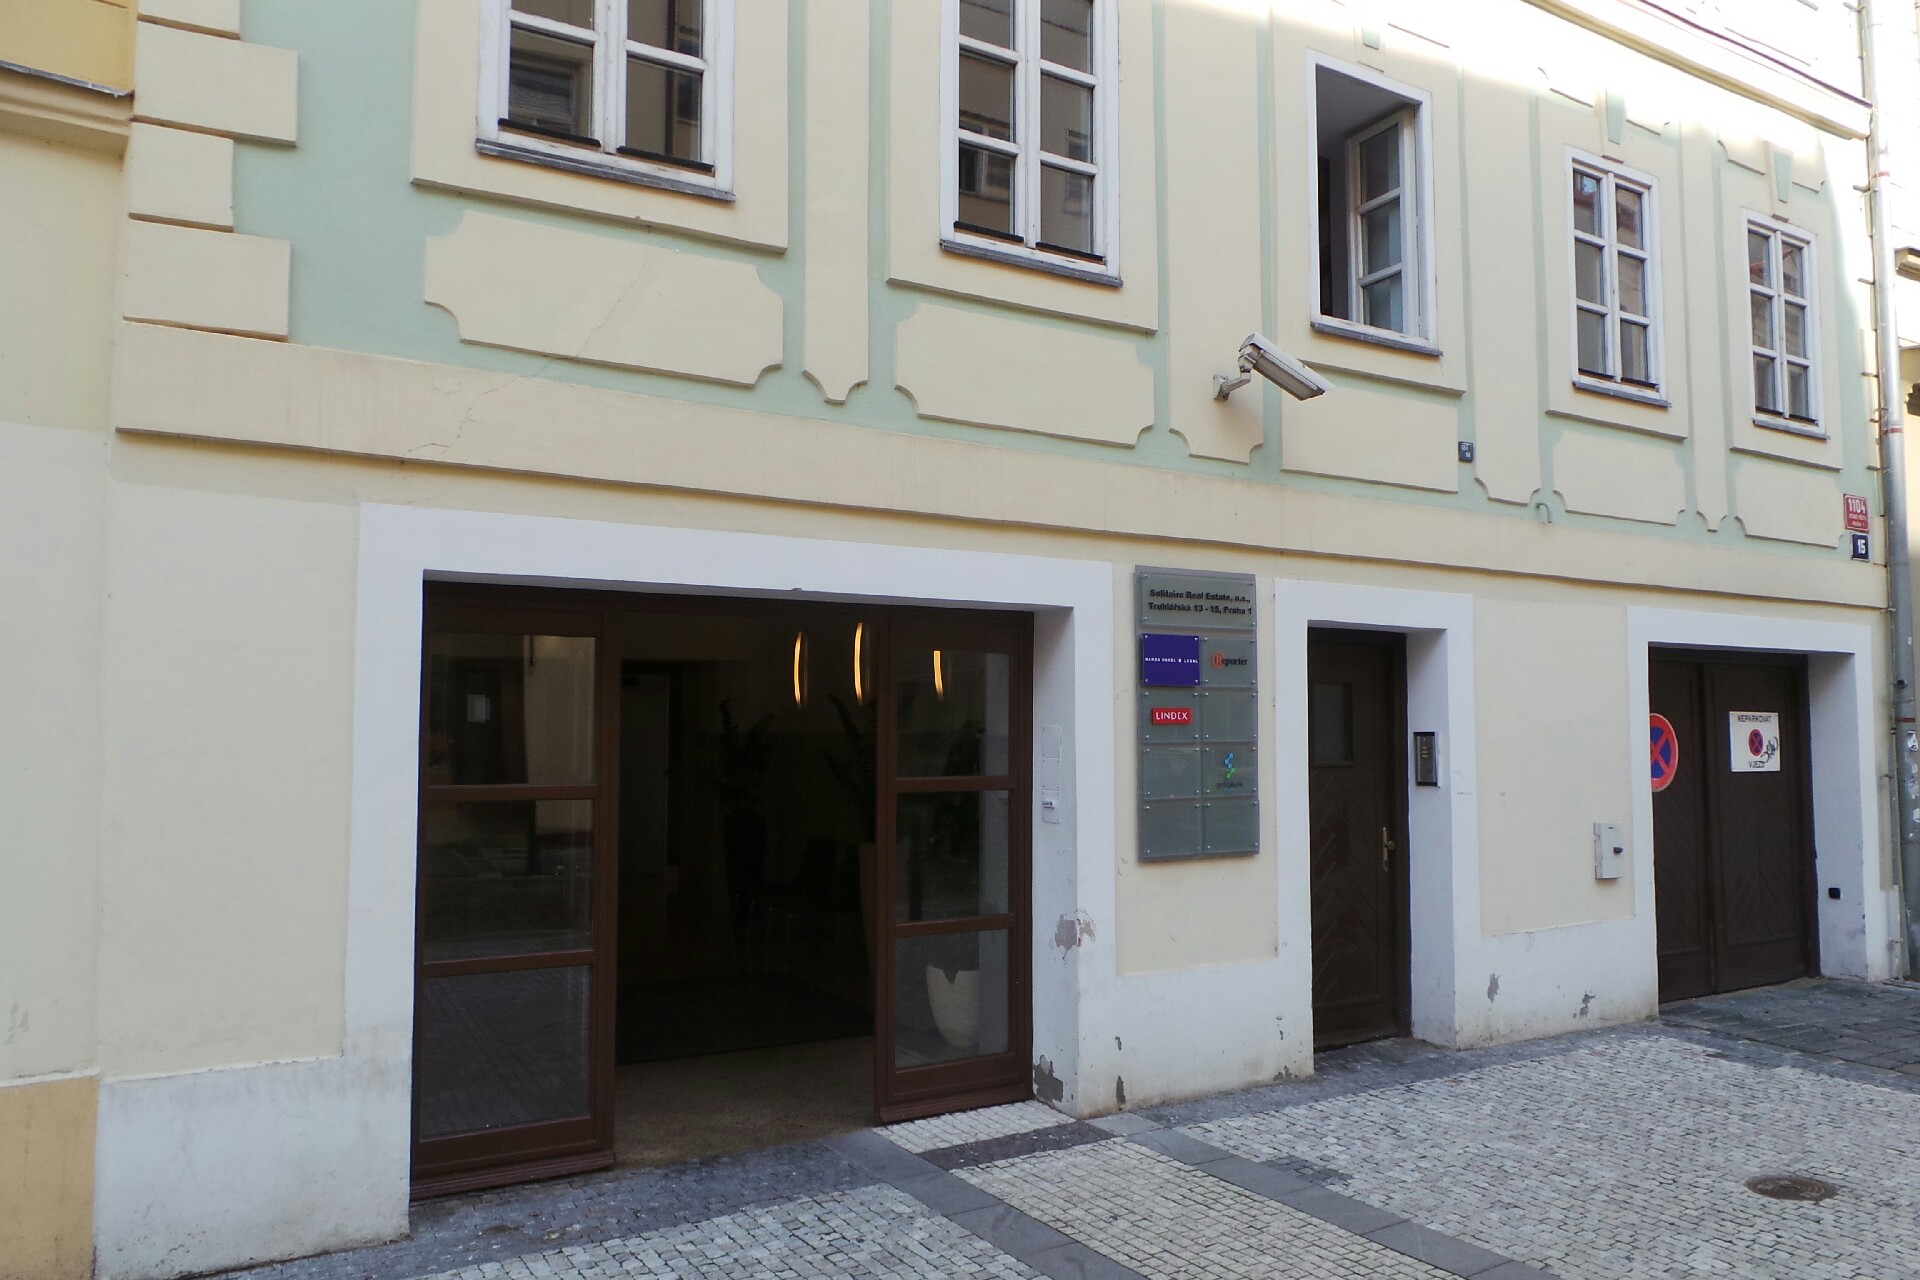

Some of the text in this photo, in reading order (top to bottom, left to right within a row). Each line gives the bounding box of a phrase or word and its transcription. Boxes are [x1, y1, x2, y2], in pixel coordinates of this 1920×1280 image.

[1848, 498, 1865, 514] 1104
[1857, 539, 1865, 553] 15
[1186, 591, 1204, 599] Real
[1205, 592, 1233, 603] Estate,
[1194, 604, 1204, 612] 13
[1210, 605, 1222, 614] 15,
[1223, 606, 1246, 615] Praha
[1247, 607, 1252, 615] 1
[1155, 711, 1189, 721] LINDEX
